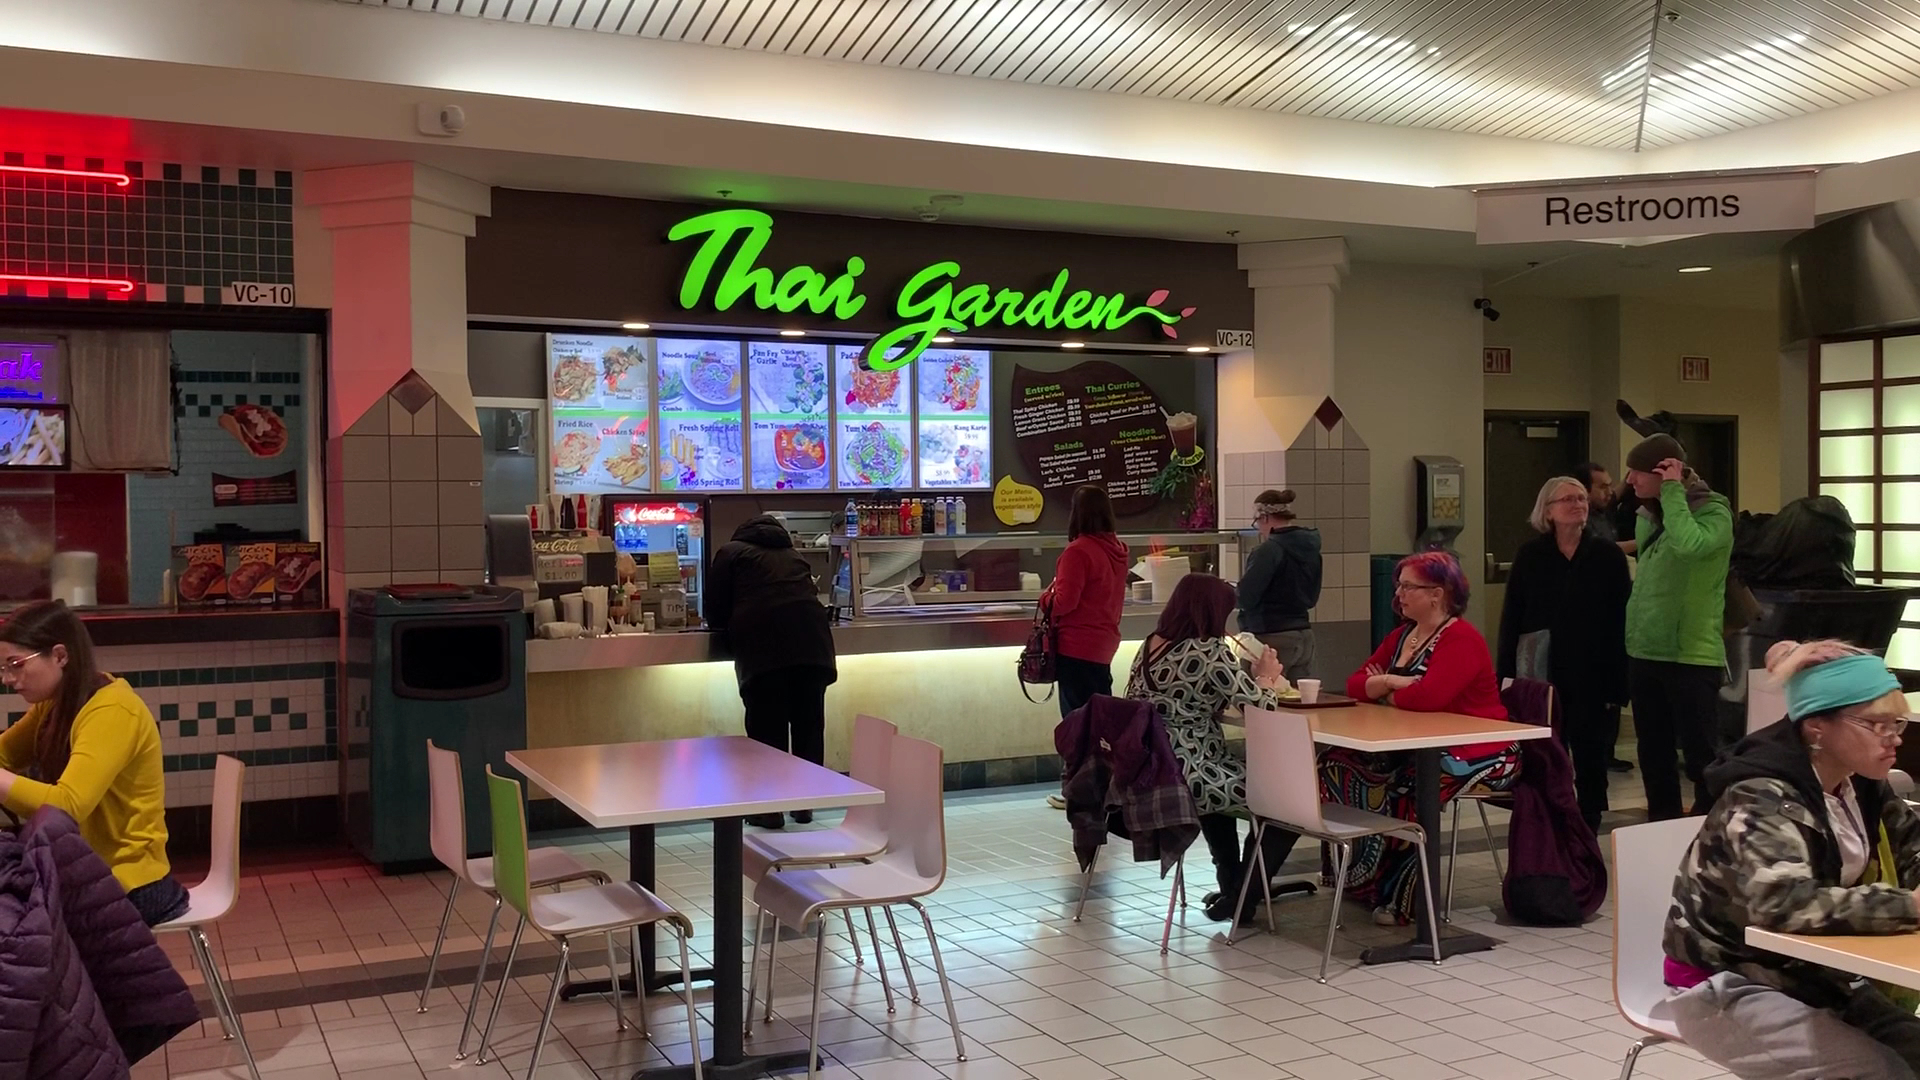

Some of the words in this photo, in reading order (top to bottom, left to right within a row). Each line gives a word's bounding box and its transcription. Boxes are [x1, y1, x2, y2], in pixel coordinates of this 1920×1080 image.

[1545, 193, 1740, 227] Restrooms
[233, 284, 292, 304] VC-10
[667, 208, 868, 320] Thai
[866, 259, 1182, 372] Garden
[1218, 331, 1252, 347] VC-12
[1484, 350, 1509, 372] EXIT
[1685, 359, 1707, 379] EXIT
[1025, 383, 1061, 396] Entrees
[1086, 384, 1105, 394] Thai
[1108, 381, 1141, 391] Curries
[1039, 402, 1058, 410] Chicken
[1045, 406, 1065, 415] Chicken
[1015, 419, 1031, 427] Lemon
[1047, 412, 1067, 420] Chicken
[700, 425, 724, 434] Spring
[1017, 428, 1047, 438] Combination
[1120, 428, 1156, 438] Noodles
[1055, 441, 1084, 451] Salads
[700, 479, 724, 488] Spring
[725, 478, 740, 486] Roll
[1044, 481, 1063, 489] Seafood
[545, 571, 577, 580] $1.00
[666, 603, 685, 613] TIPS
